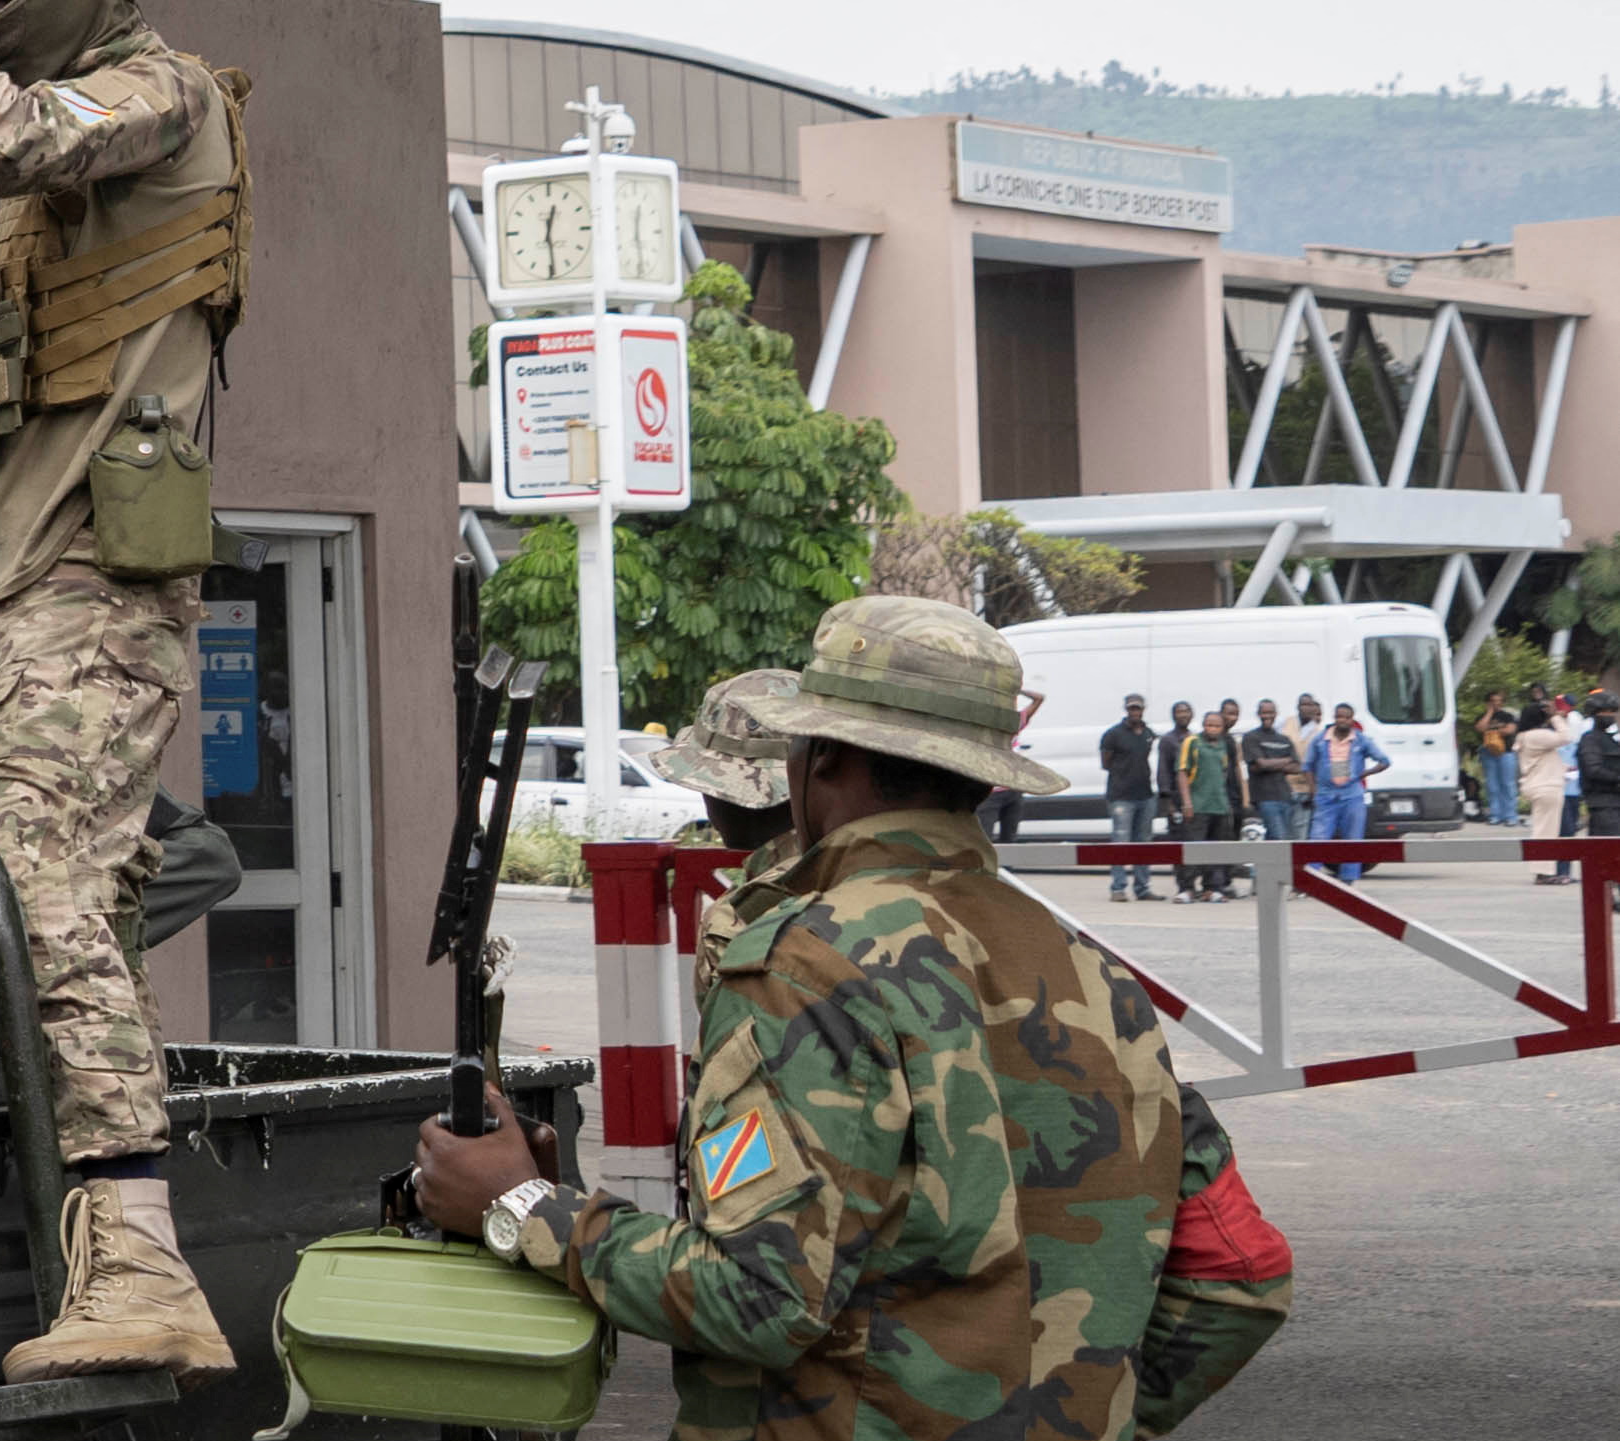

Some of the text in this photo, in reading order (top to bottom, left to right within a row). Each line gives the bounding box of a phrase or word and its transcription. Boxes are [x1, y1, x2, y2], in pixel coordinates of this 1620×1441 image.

[973, 170, 1221, 223] LA CORNICHE ONE STOP BORDER POST
[516, 360, 589, 378] Contact Us
